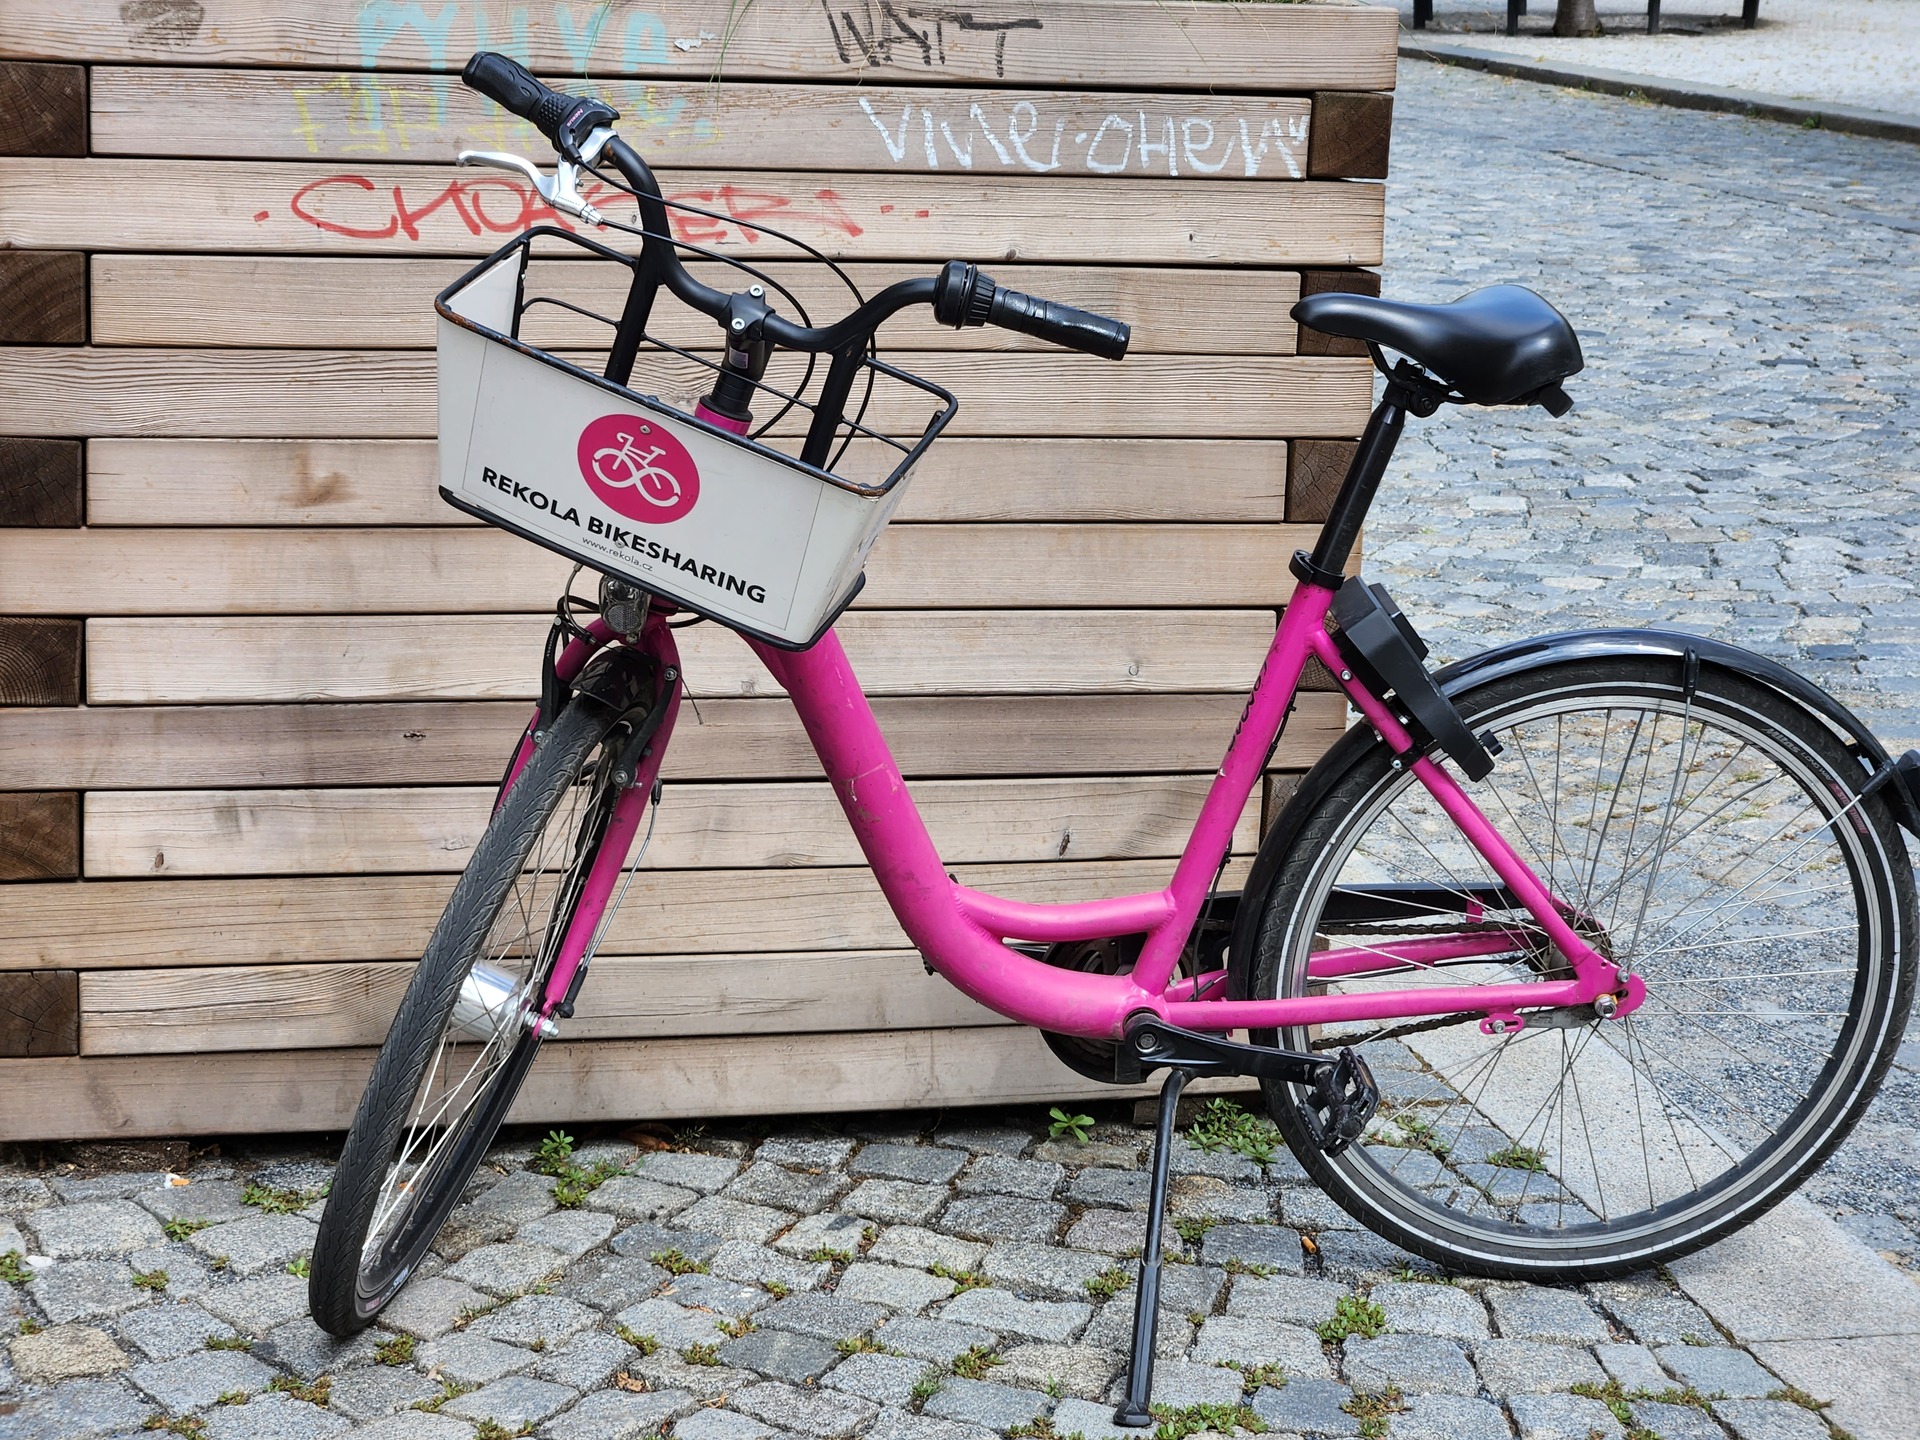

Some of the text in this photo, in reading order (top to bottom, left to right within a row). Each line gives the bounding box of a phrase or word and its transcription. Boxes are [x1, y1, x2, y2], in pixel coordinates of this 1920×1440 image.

[482, 466, 767, 604] REKOLA BIKESHARING
[582, 537, 654, 572] www.rekola.cz
